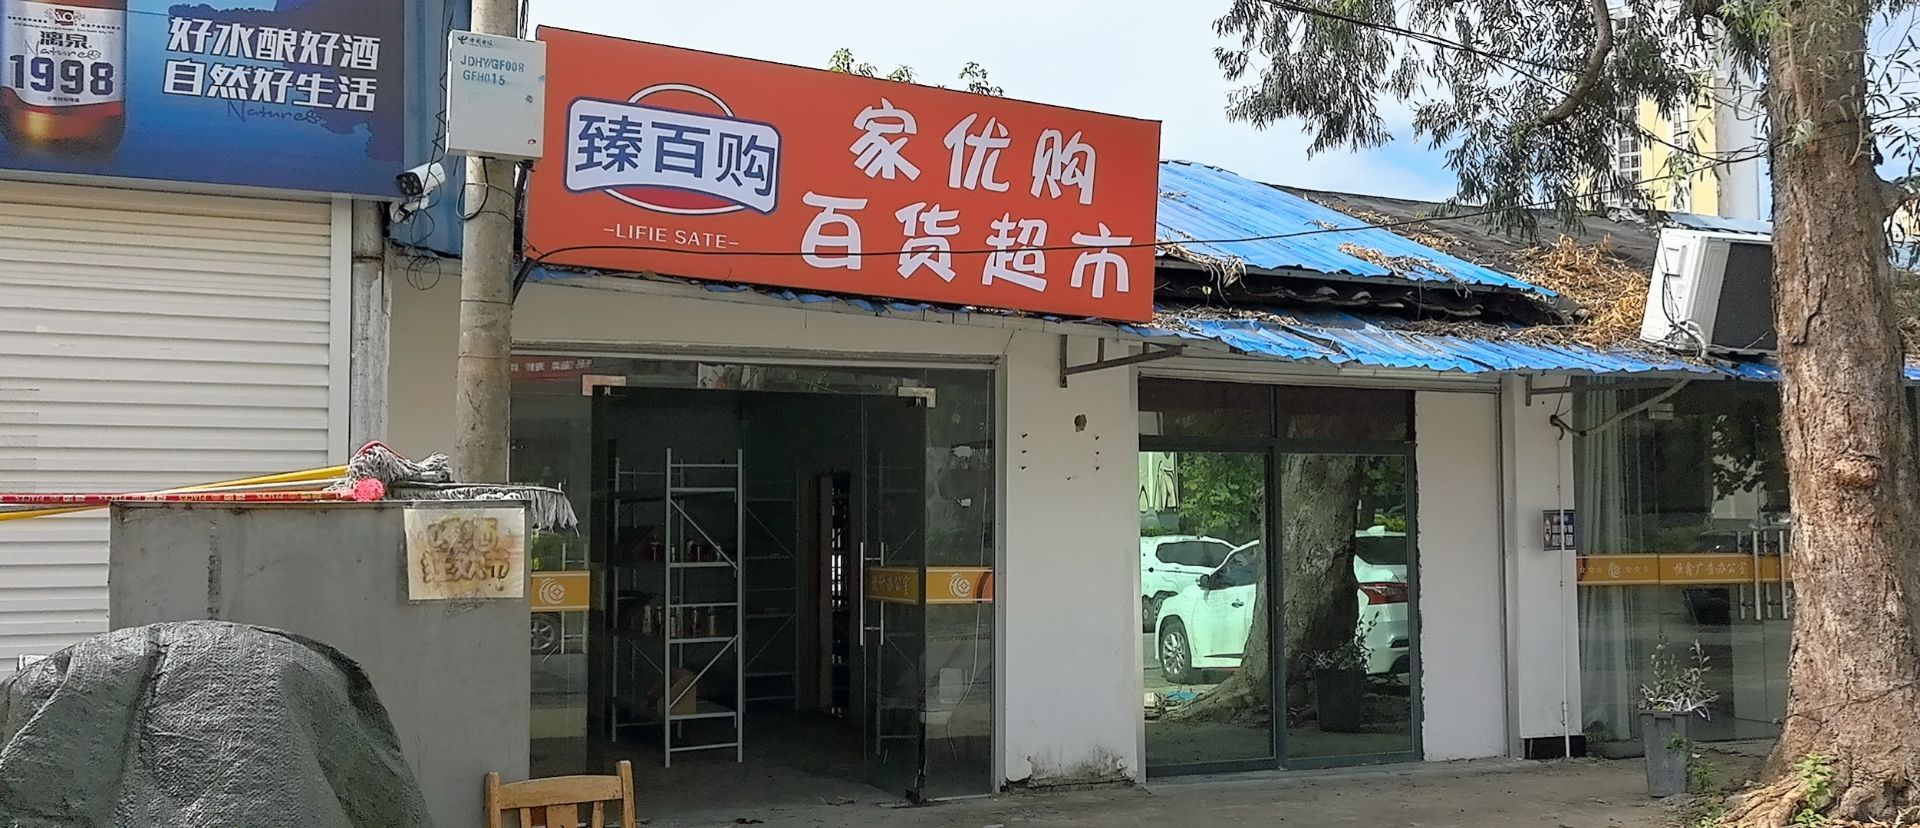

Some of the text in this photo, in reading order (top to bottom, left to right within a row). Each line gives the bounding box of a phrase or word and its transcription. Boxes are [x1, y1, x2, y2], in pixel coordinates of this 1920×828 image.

[167, 17, 381, 71] 好水酿好酒
[461, 55, 525, 73] JDHY/GF008
[10, 55, 114, 96] 1998
[163, 58, 377, 112] 自然好生活
[463, 70, 506, 86] GFH015
[575, 113, 776, 198] 臻百购
[849, 97, 1098, 206] 家优购
[800, 190, 1133, 300] 百货超市
